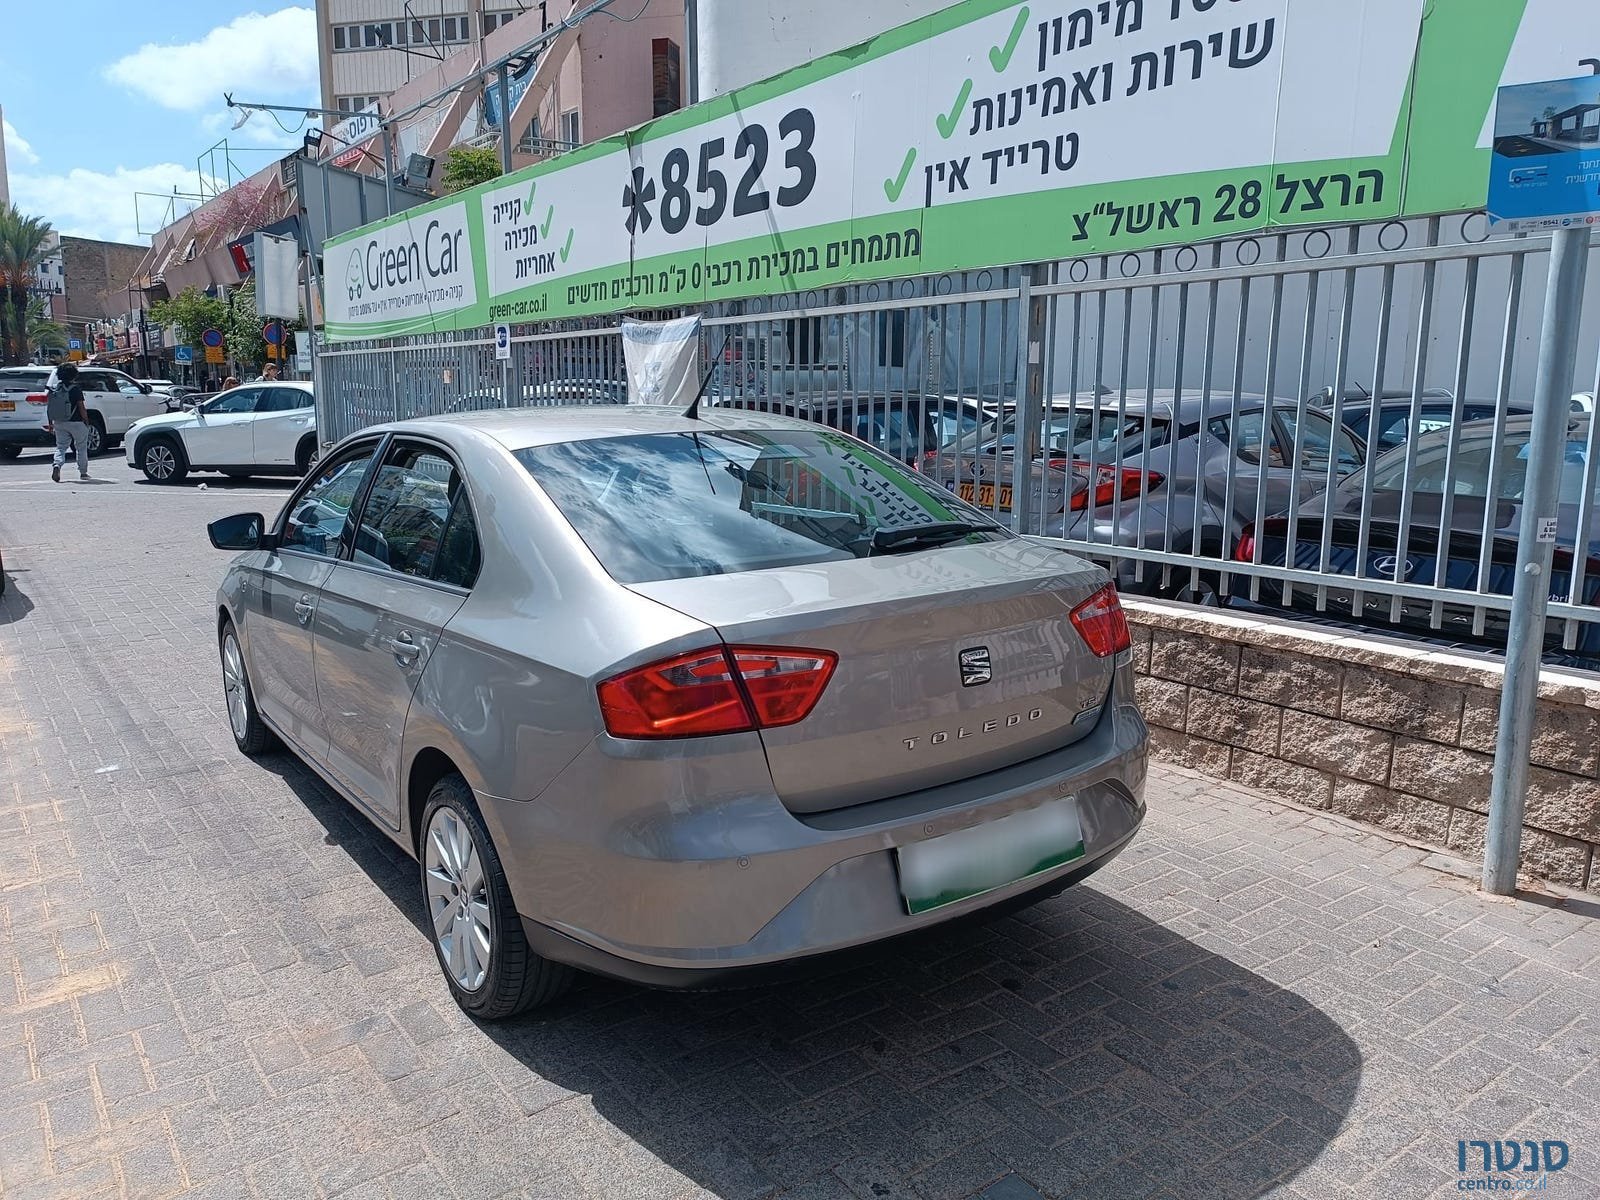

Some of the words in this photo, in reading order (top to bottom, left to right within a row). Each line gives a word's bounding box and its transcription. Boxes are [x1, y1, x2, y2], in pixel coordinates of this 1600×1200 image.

[1038, 0, 1144, 72] מימון
[1126, 18, 1275, 97] שירות
[969, 62, 1113, 136] ואמינות
[982, 132, 1079, 185] טרייד
[925, 156, 971, 208] אין
[1213, 180, 1263, 223] 28
[1275, 169, 1384, 214] הרצל
[493, 198, 521, 225] קנייה
[366, 240, 420, 291] Green
[425, 220, 463, 278] Car
[504, 224, 538, 251] מכירה
[826, 228, 921, 269] מתמחים
[515, 251, 556, 280] אחריות
[705, 259, 742, 287] רכבי
[747, 246, 819, 281] במכירת
[489, 292, 548, 322] green-car.co.il
[567, 281, 607, 305] חדשים
[611, 274, 654, 299] ורכבים
[903, 708, 1043, 750] TOLEDO
